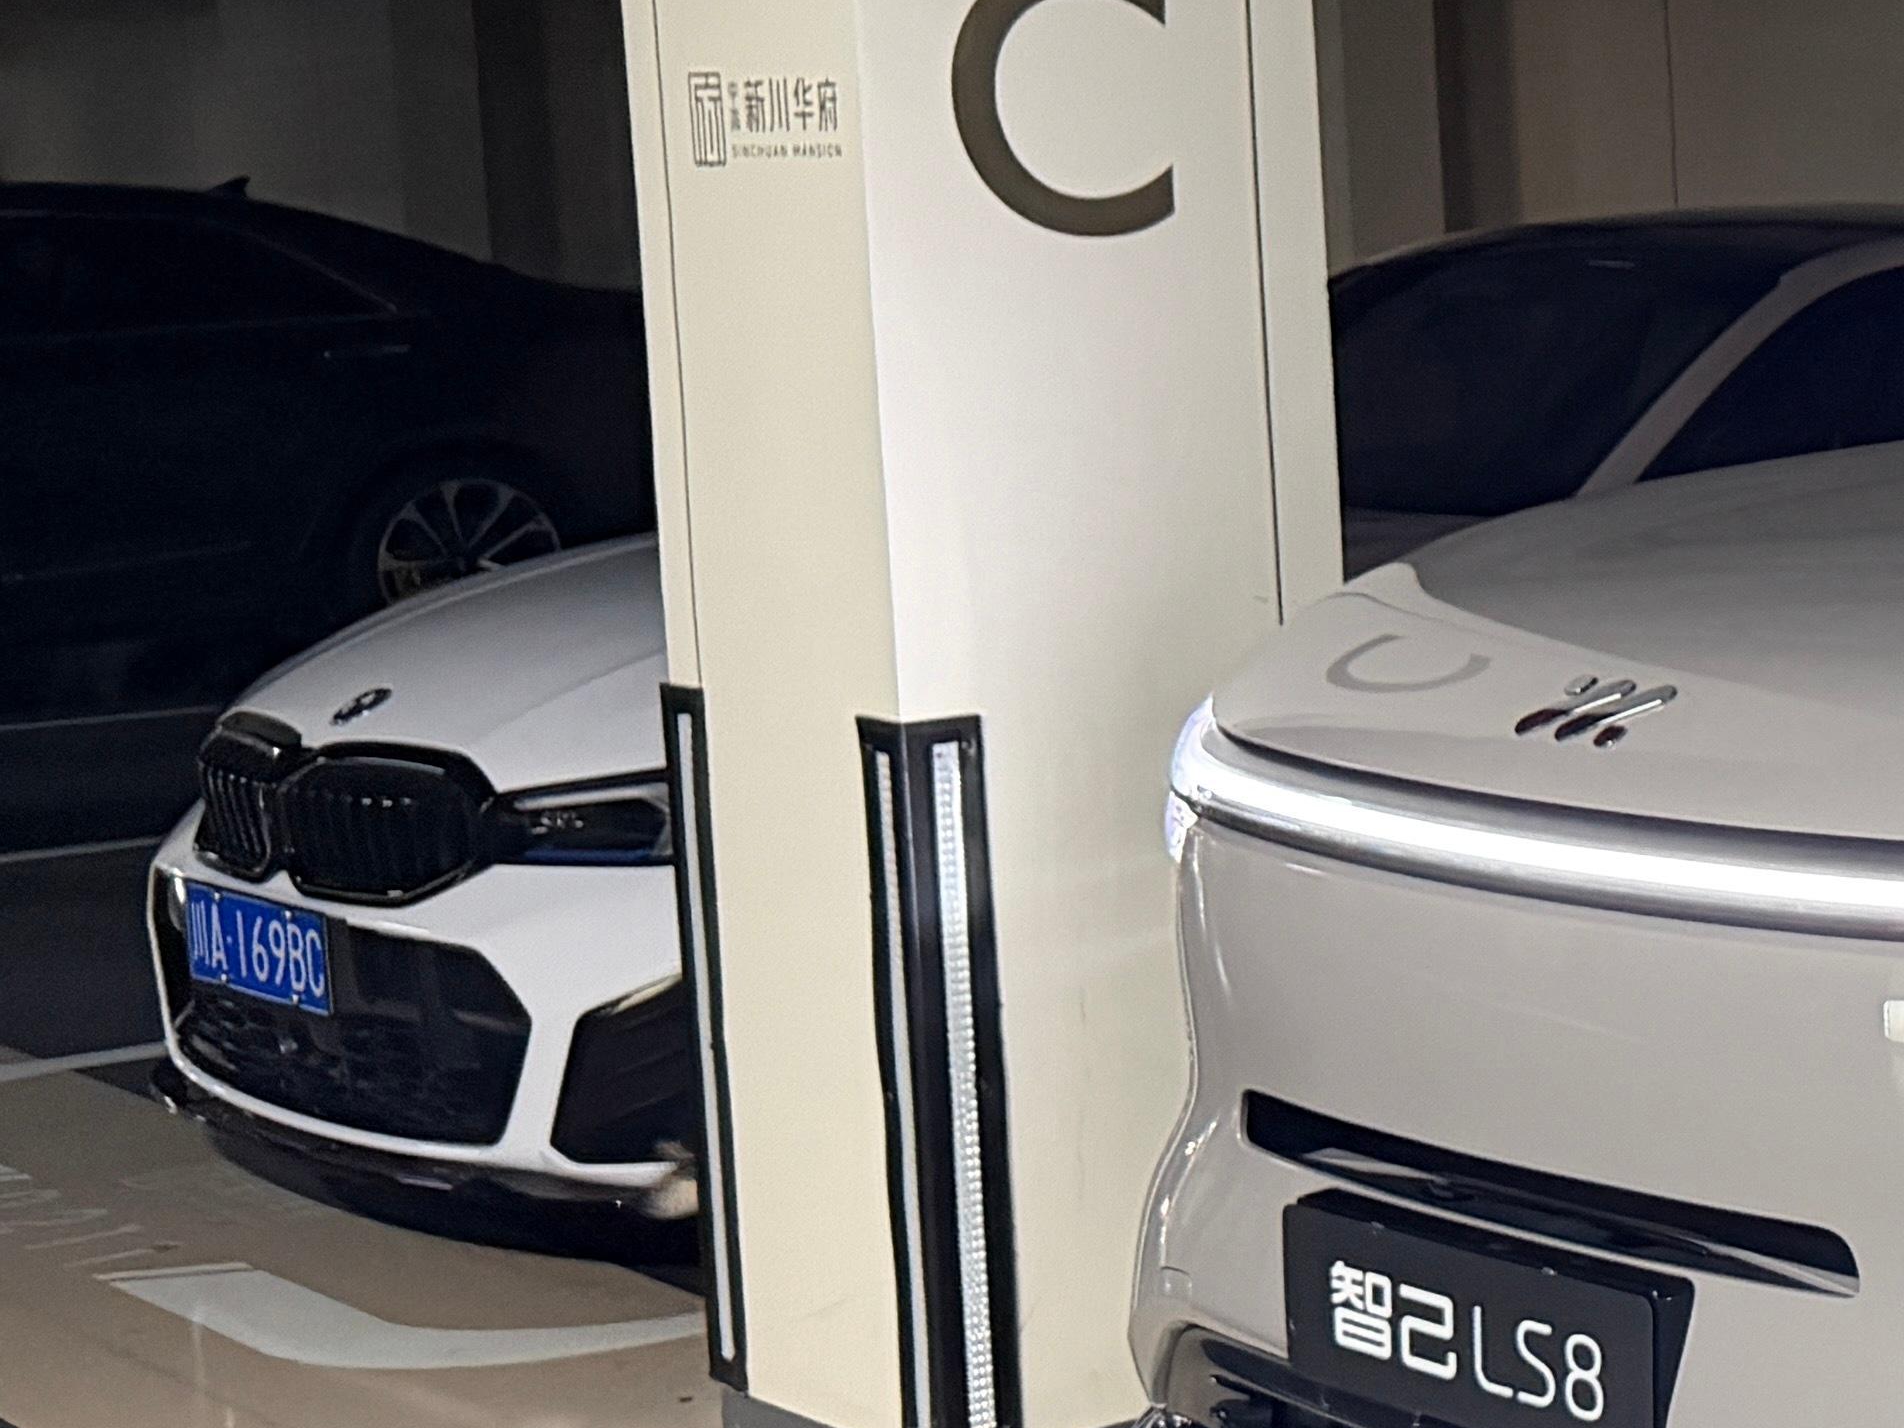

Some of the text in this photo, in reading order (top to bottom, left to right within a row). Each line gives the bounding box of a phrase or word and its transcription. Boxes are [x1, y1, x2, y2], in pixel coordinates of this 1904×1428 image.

[743, 76, 838, 133] 新川华府
[731, 142, 843, 158] SINCHUAN MANSION
[1329, 1259, 1605, 1422] 智己 LS8
